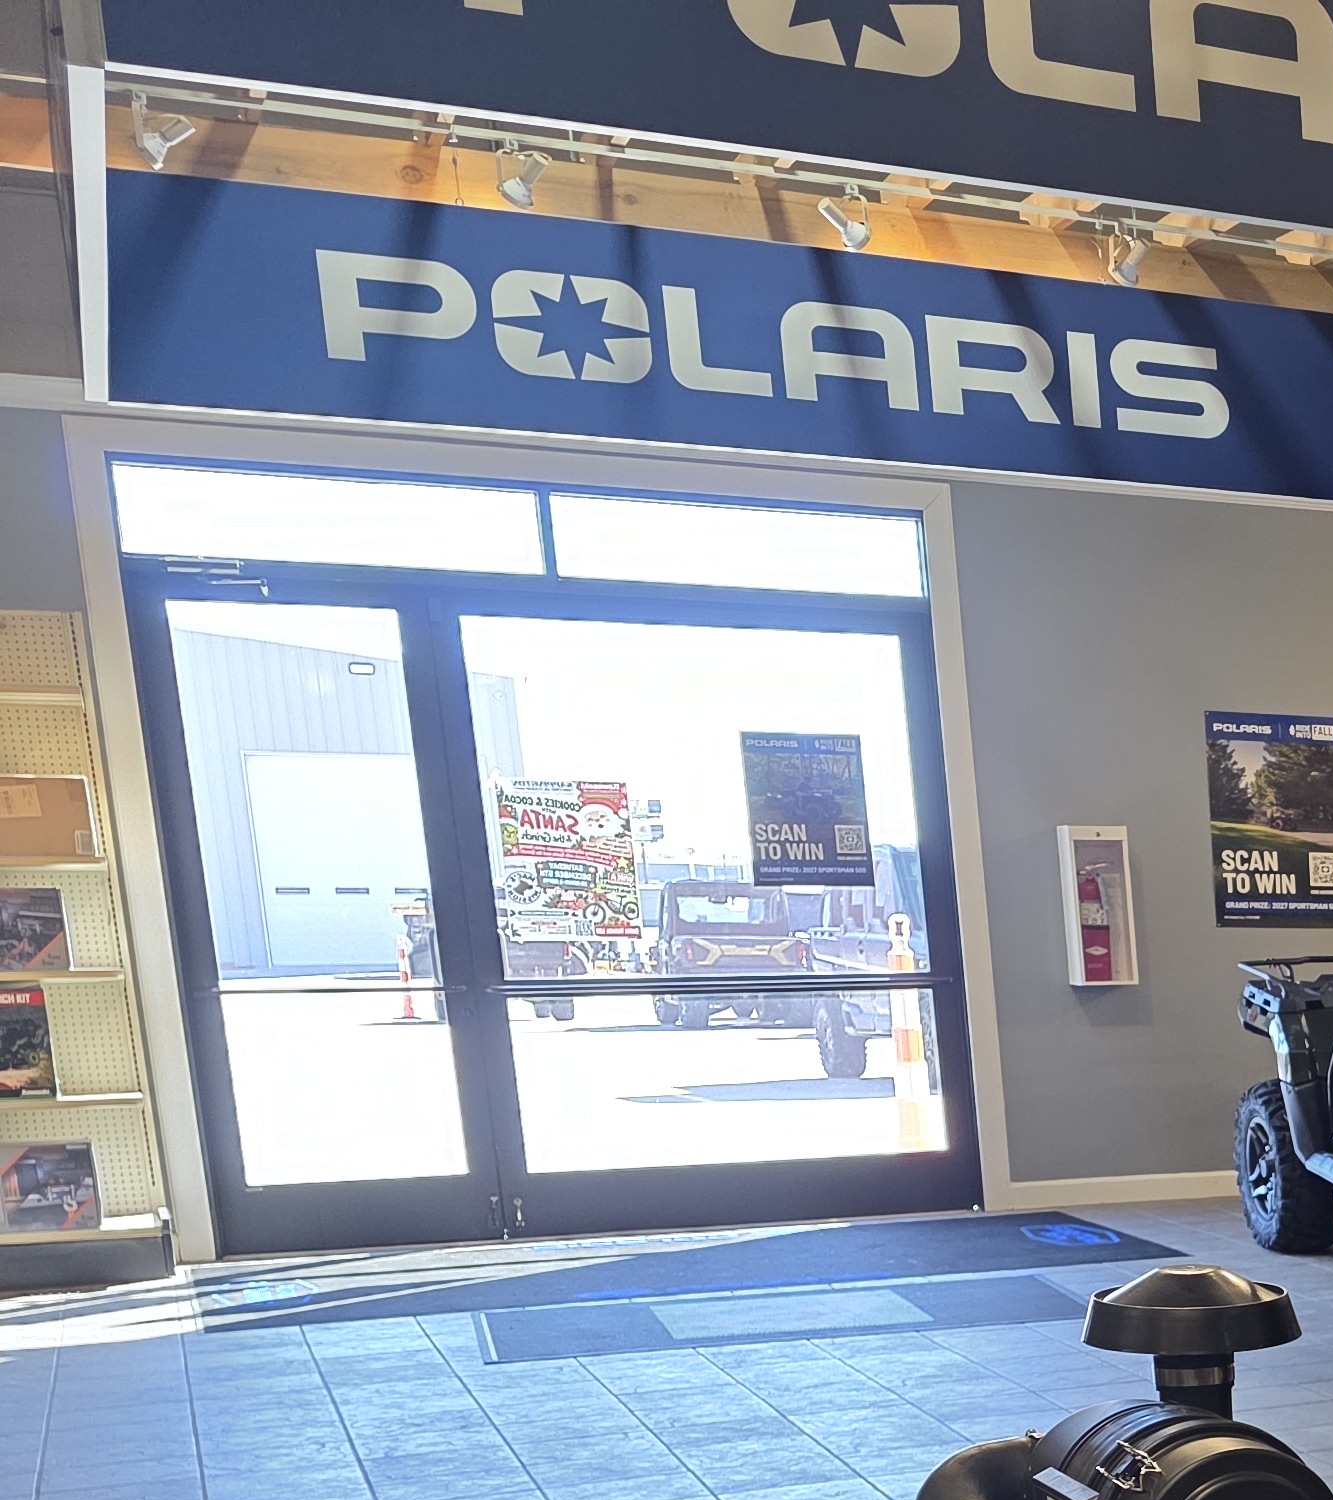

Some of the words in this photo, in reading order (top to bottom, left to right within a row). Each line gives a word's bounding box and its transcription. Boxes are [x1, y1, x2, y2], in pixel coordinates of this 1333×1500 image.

[314, 247, 1231, 440] POLARIS
[1212, 722, 1272, 734] POLARIS
[1312, 724, 1333, 737] FALL
[745, 738, 798, 747] POLARIS
[753, 822, 807, 841] SCAN
[755, 842, 782, 860] TO
[785, 842, 824, 860] WIN
[1220, 848, 1279, 872] SCAN
[1222, 871, 1251, 894] TO
[1253, 872, 1297, 894] WIN
[1288, 901, 1328, 910] SPORTSMAN
[16, 993, 31, 1004] KIT
